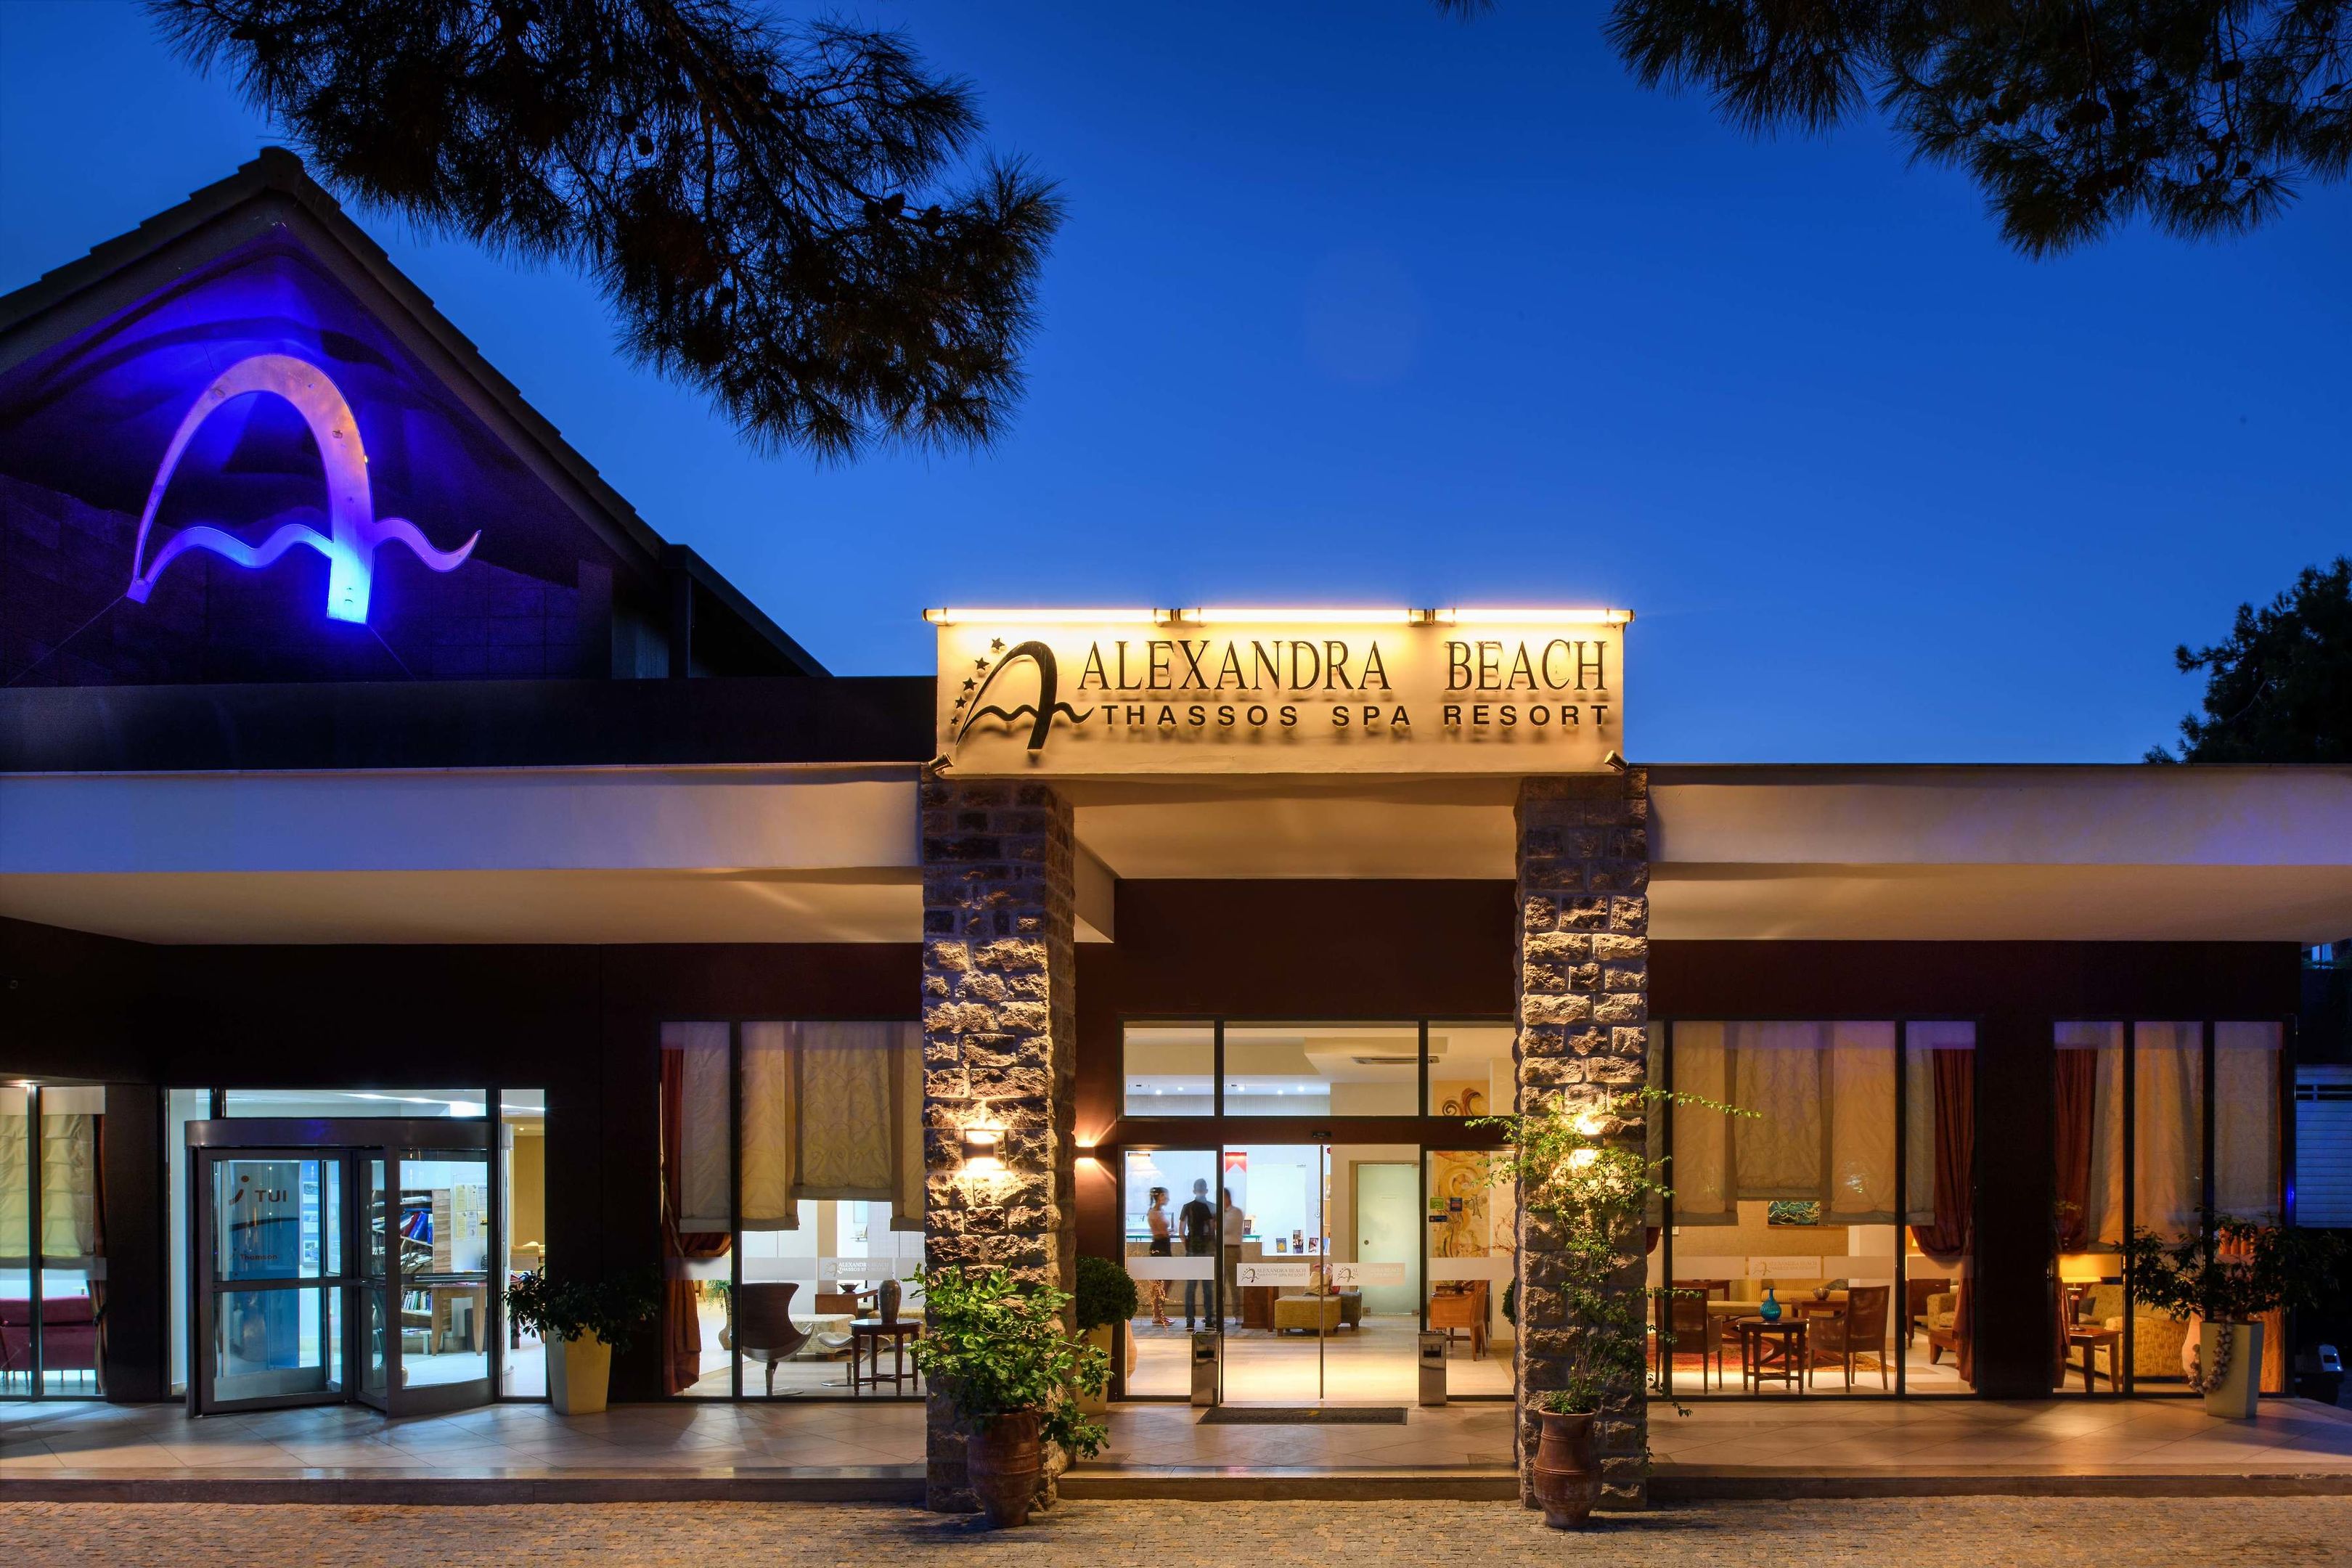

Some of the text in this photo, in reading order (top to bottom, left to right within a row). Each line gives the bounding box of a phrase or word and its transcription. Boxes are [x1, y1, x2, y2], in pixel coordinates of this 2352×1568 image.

[1077, 639, 1608, 690] ALEXANDRA BEACH
[1101, 704, 1608, 727] THASSOS SPA RESORT
[255, 1190, 288, 1203] TUI
